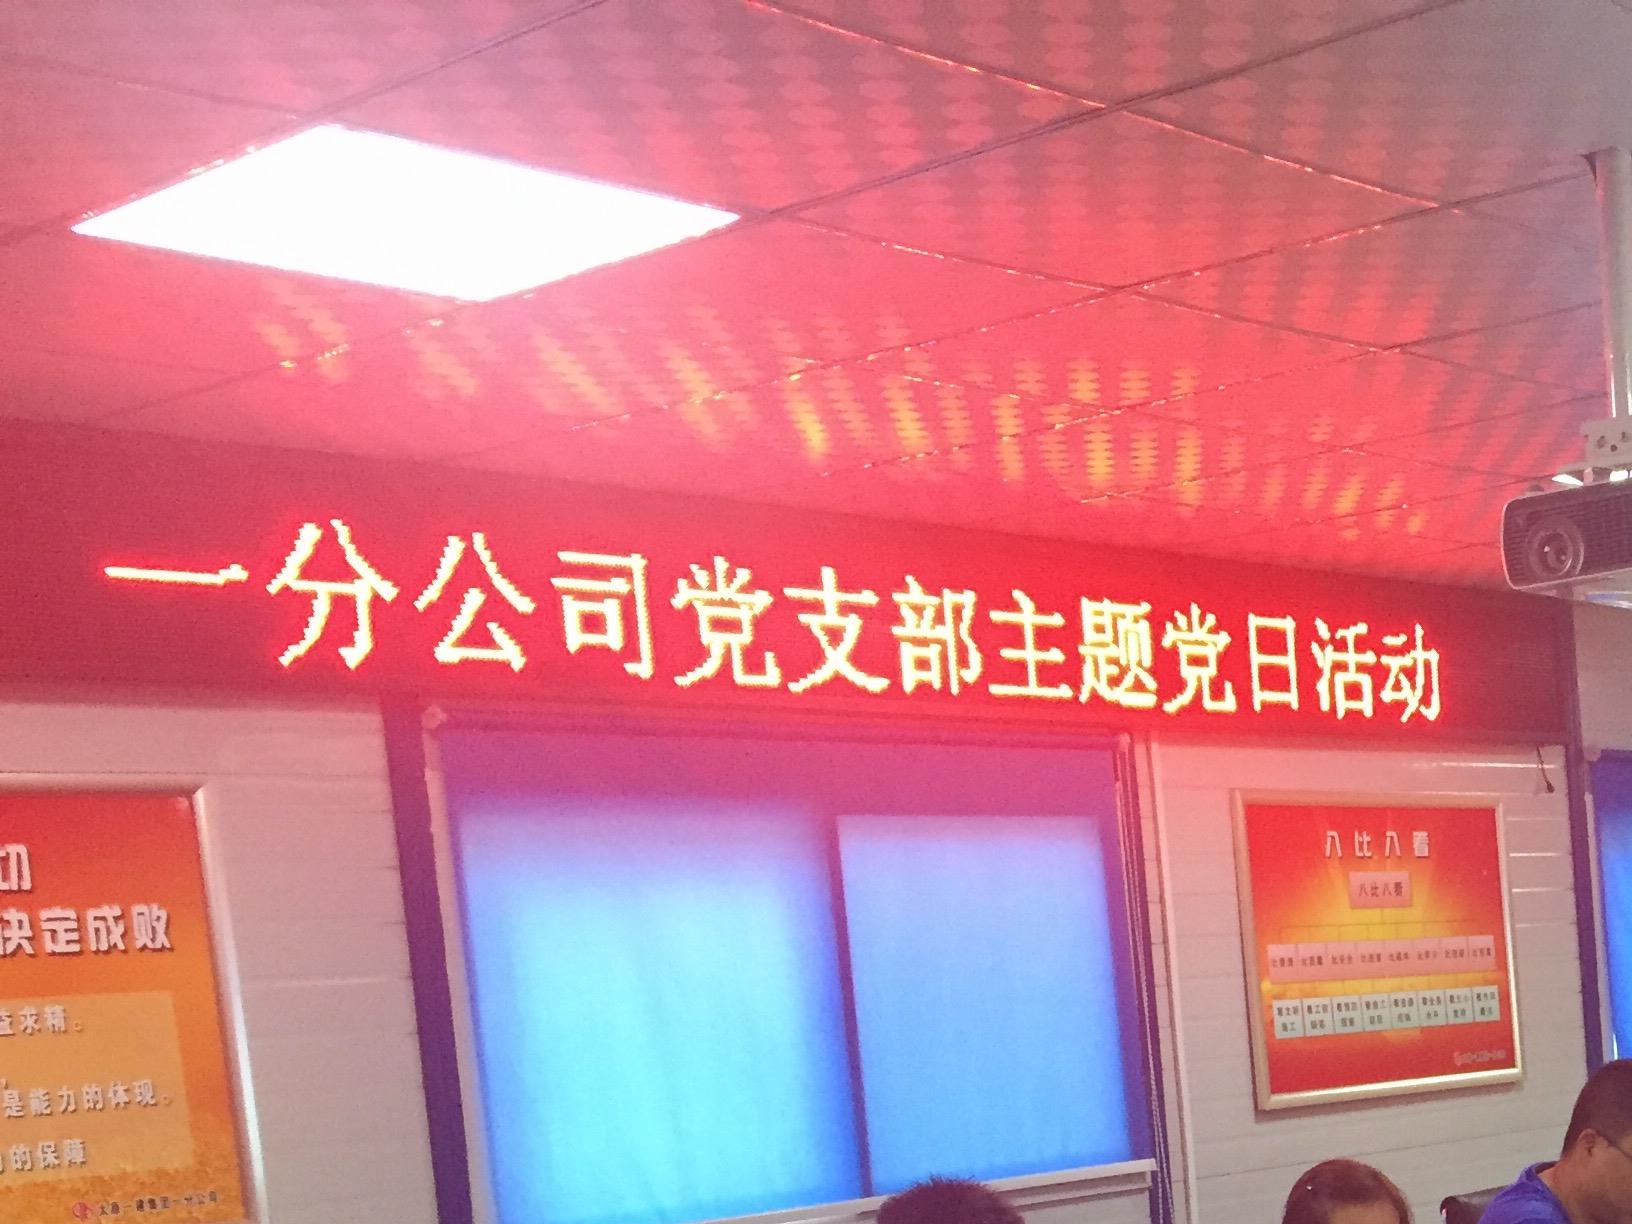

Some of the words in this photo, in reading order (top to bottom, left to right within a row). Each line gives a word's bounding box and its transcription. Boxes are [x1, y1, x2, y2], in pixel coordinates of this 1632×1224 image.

[103, 518, 1441, 723] 一分公司党支部主题党日活动
[1325, 830, 1430, 857] 八比八看
